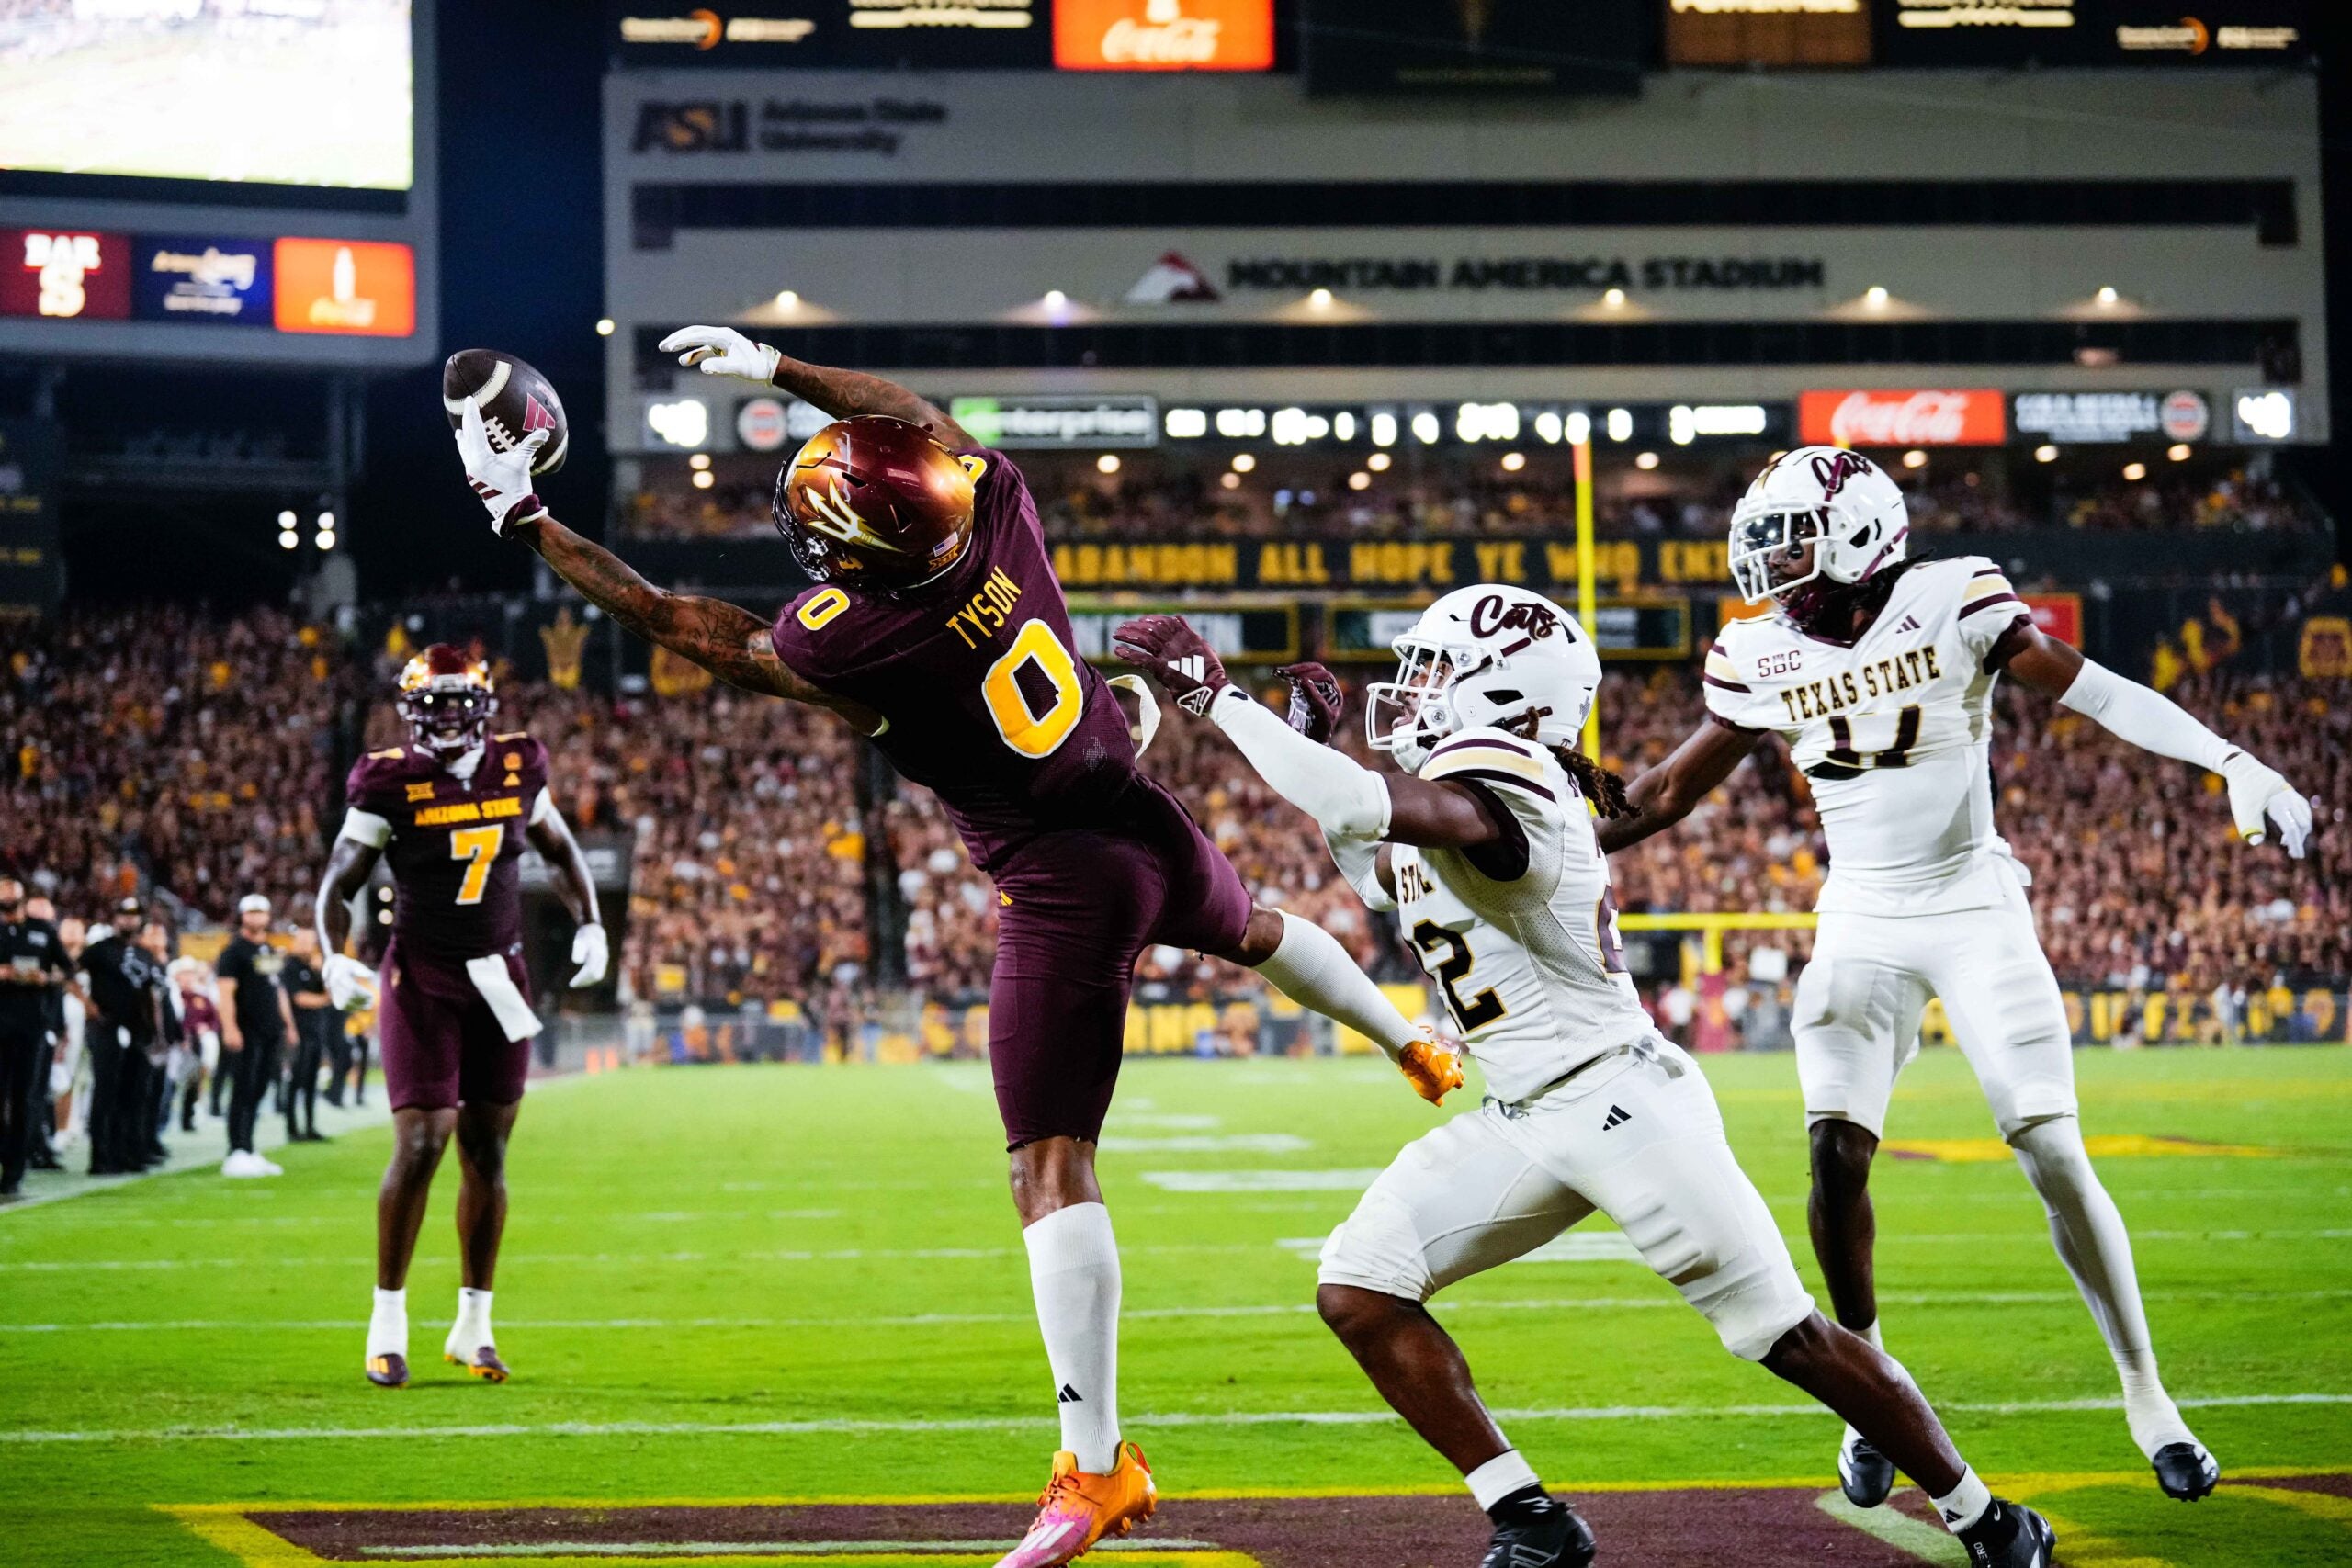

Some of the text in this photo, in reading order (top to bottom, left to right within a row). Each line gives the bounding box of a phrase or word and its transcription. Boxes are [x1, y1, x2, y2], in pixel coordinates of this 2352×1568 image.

[1227, 256, 1825, 291] MOUNTAIN AMERICA STADIUM
[1259, 543, 1329, 583] ALL
[1350, 542, 1455, 583] HOPE
[1475, 541, 1526, 583] YE
[797, 587, 850, 631] 0
[945, 564, 1022, 649] TYSON
[1470, 594, 1562, 641] Cats
[981, 617, 1083, 759] 0
[1780, 644, 1942, 723] TEXAS STATE
[450, 824, 505, 905] 7
[1404, 918, 1510, 1036] 2
